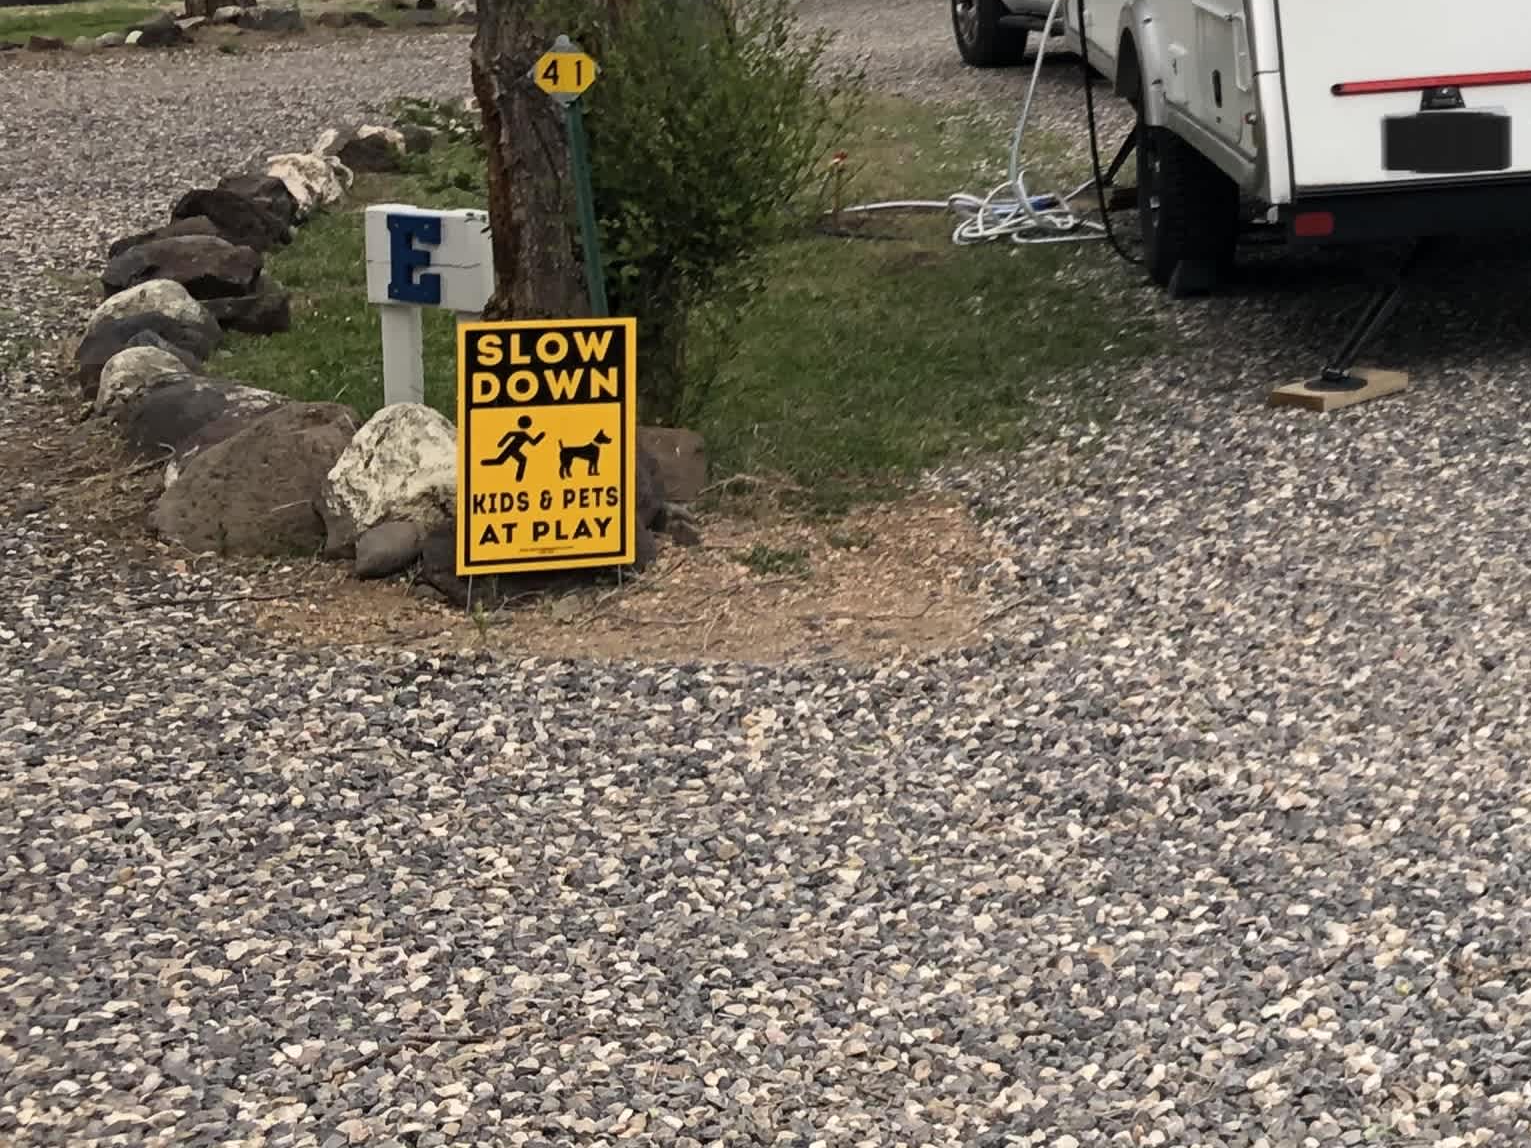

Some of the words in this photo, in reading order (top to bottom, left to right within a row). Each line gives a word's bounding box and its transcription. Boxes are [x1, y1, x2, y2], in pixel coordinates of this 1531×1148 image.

[541, 59, 582, 87] 41
[387, 214, 441, 304] E
[477, 330, 613, 366] SLOW
[472, 367, 618, 403] DOWN
[473, 492, 529, 514] KIDS
[540, 490, 552, 510] &
[563, 486, 618, 508] PETS
[480, 522, 518, 545] AT
[532, 517, 612, 541] PLAY
